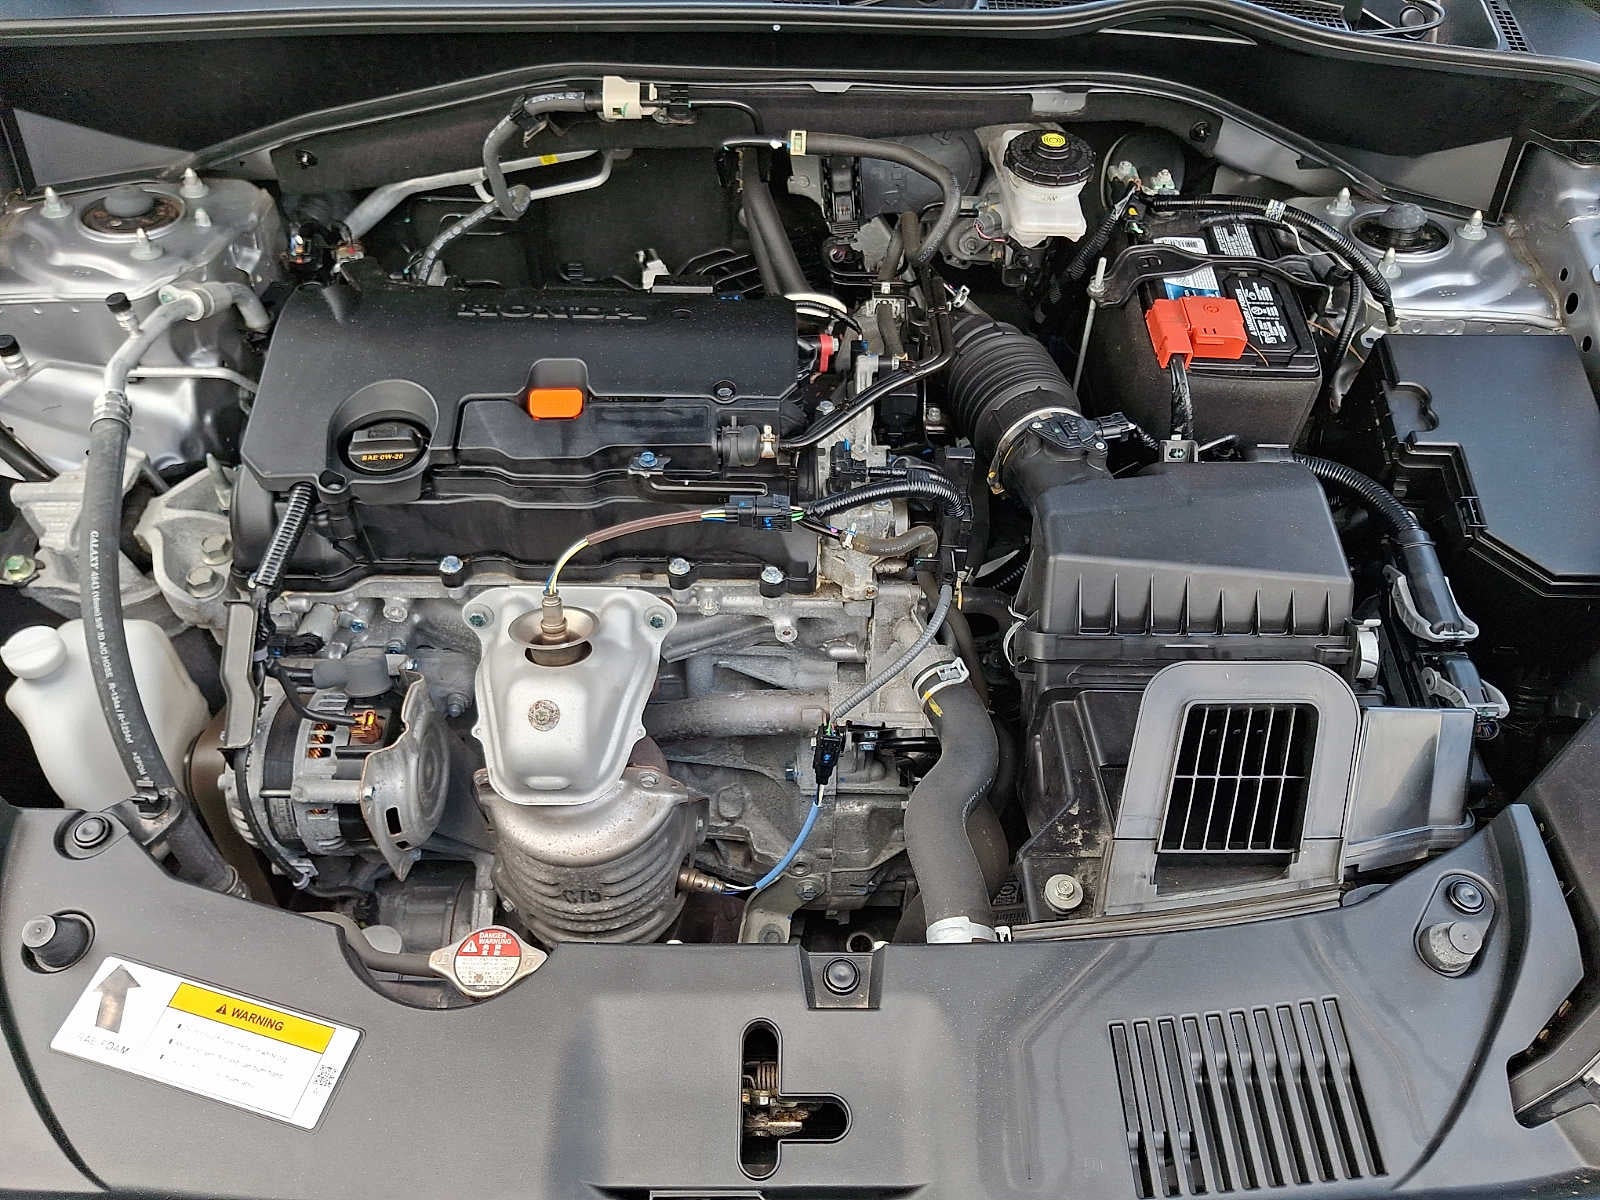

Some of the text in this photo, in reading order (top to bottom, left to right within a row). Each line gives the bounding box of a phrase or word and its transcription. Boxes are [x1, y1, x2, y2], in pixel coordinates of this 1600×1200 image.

[456, 303, 649, 322] HONDA
[361, 454, 379, 462] SAE
[89, 530, 100, 570] GALAXY
[102, 655, 114, 679] HOSE
[230, 1006, 285, 1032] WARNING
